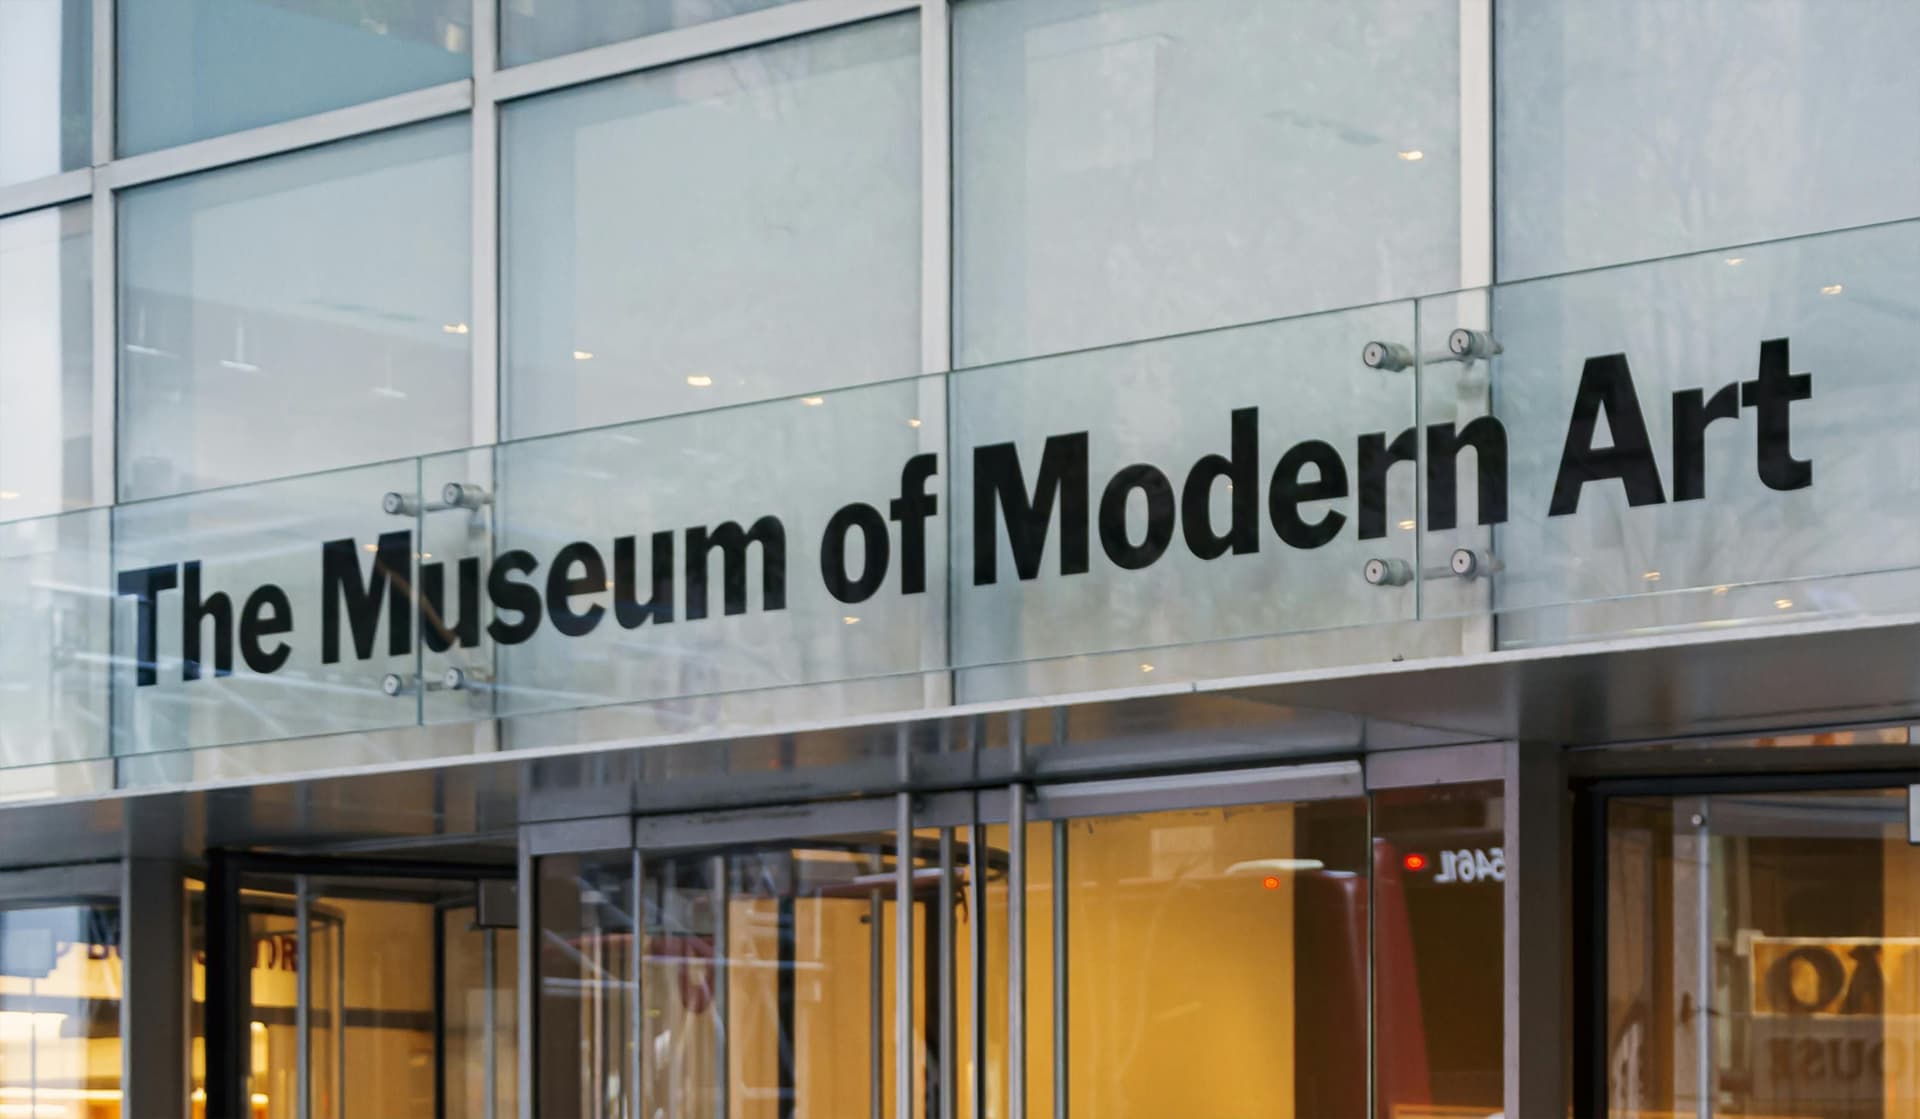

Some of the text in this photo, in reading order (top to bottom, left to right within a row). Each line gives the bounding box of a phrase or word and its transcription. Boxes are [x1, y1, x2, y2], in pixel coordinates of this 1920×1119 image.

[118, 337, 1813, 686] The Museum of Modern Art
